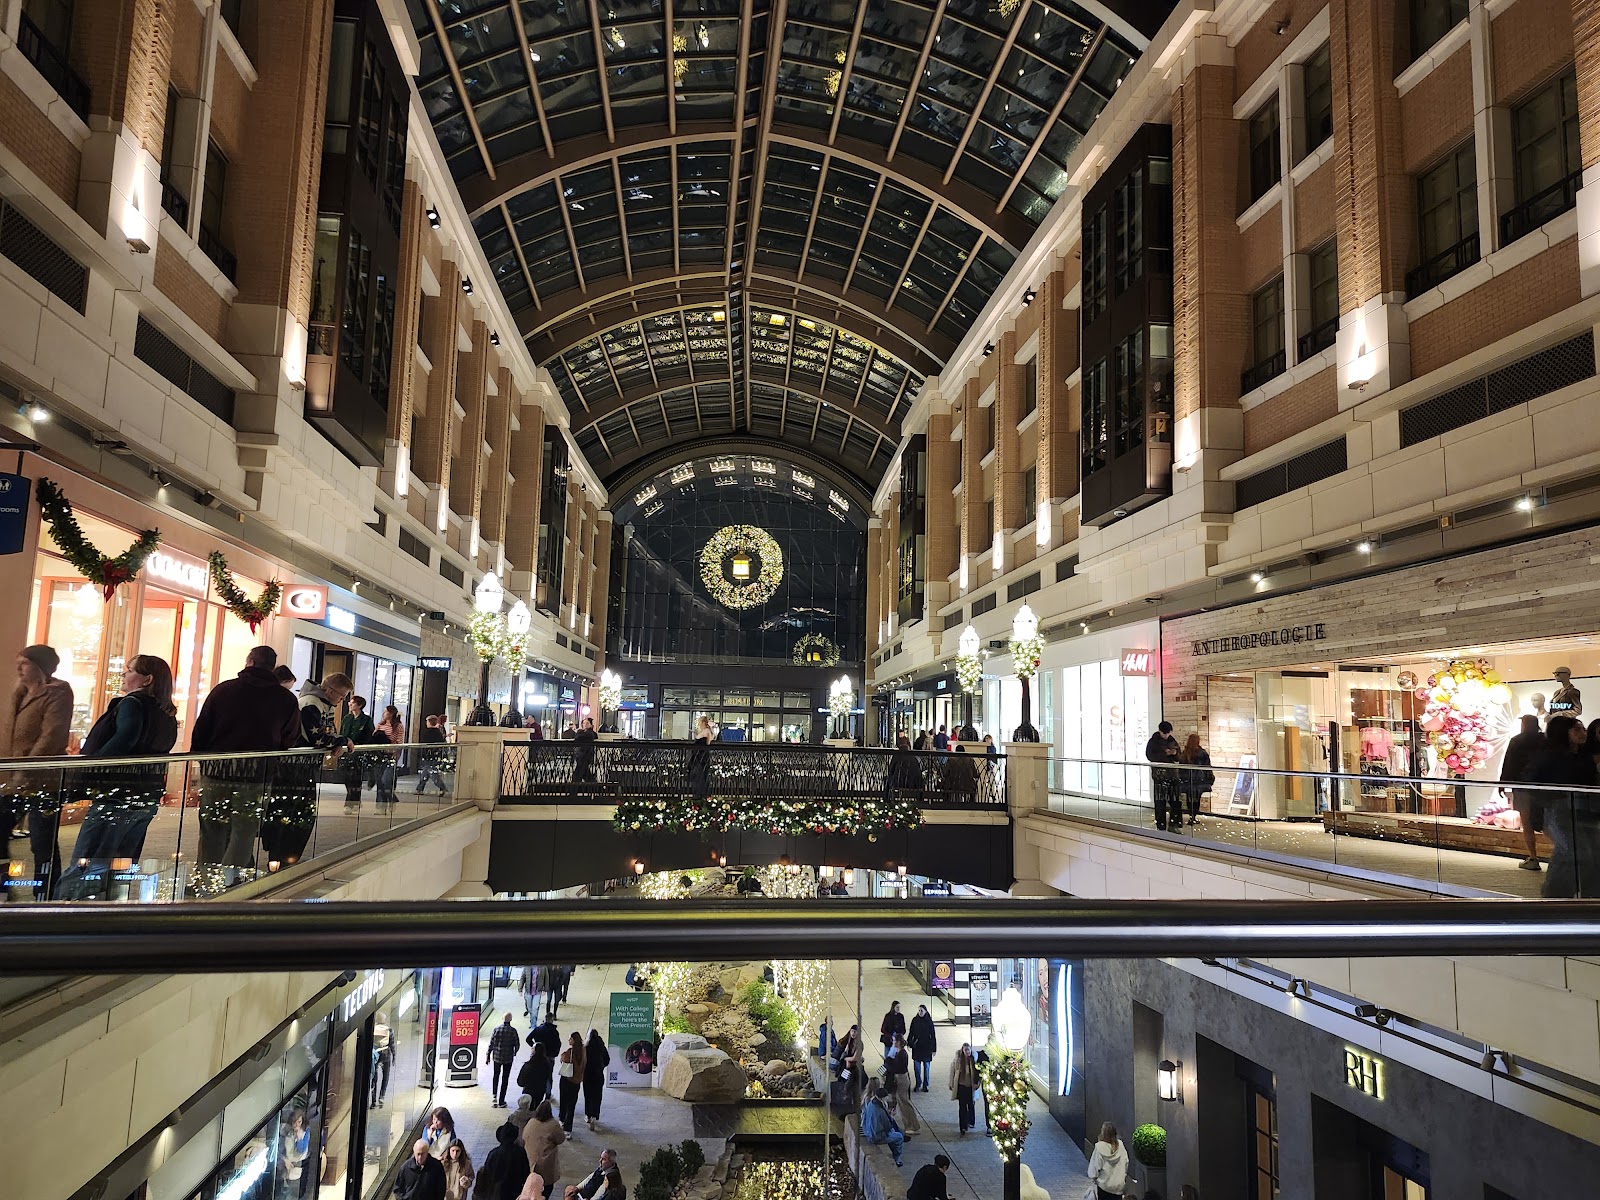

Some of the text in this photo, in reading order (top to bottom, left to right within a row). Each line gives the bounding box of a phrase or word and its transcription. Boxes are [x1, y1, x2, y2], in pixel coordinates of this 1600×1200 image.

[1191, 623, 1326, 657] ANTHROPOLOGIE
[1122, 653, 1148, 672] H&M
[343, 967, 385, 1023] TECOVAS
[455, 1018, 475, 1026] BOGO
[1343, 1047, 1379, 1099] RH
